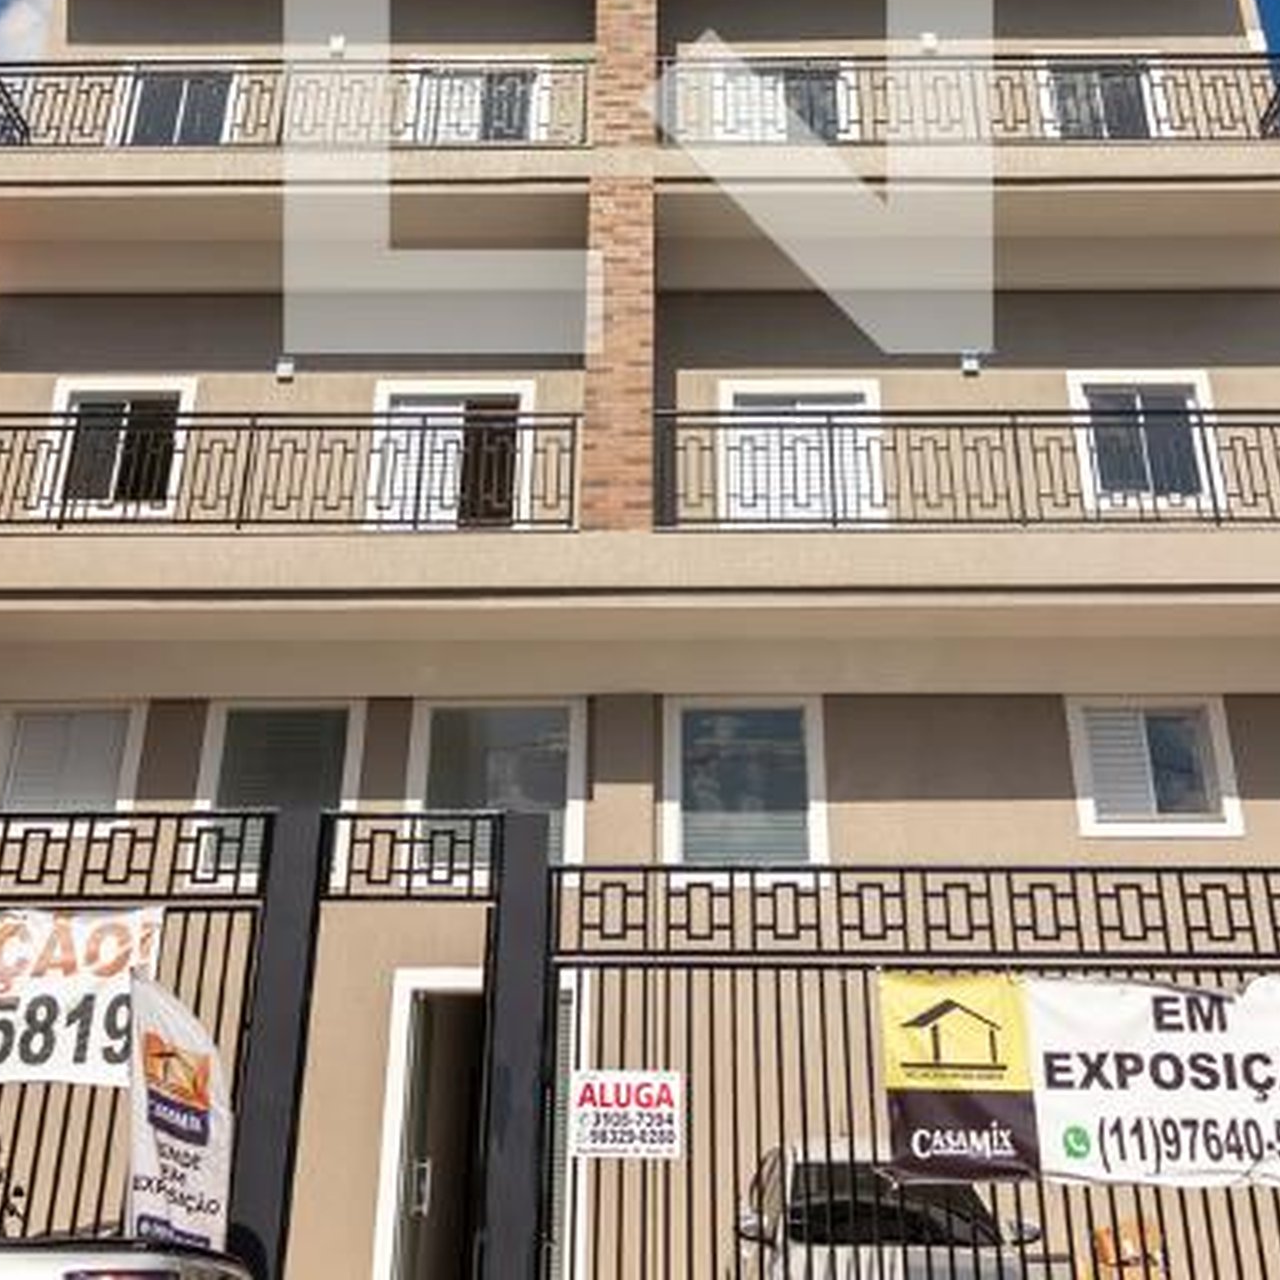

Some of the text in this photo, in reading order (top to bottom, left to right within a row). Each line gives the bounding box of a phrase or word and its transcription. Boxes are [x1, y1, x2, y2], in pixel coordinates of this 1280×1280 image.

[1151, 995, 1229, 1033] EM
[577, 1081, 674, 1109] ALUGA
[157, 1141, 202, 1171] ENDE
